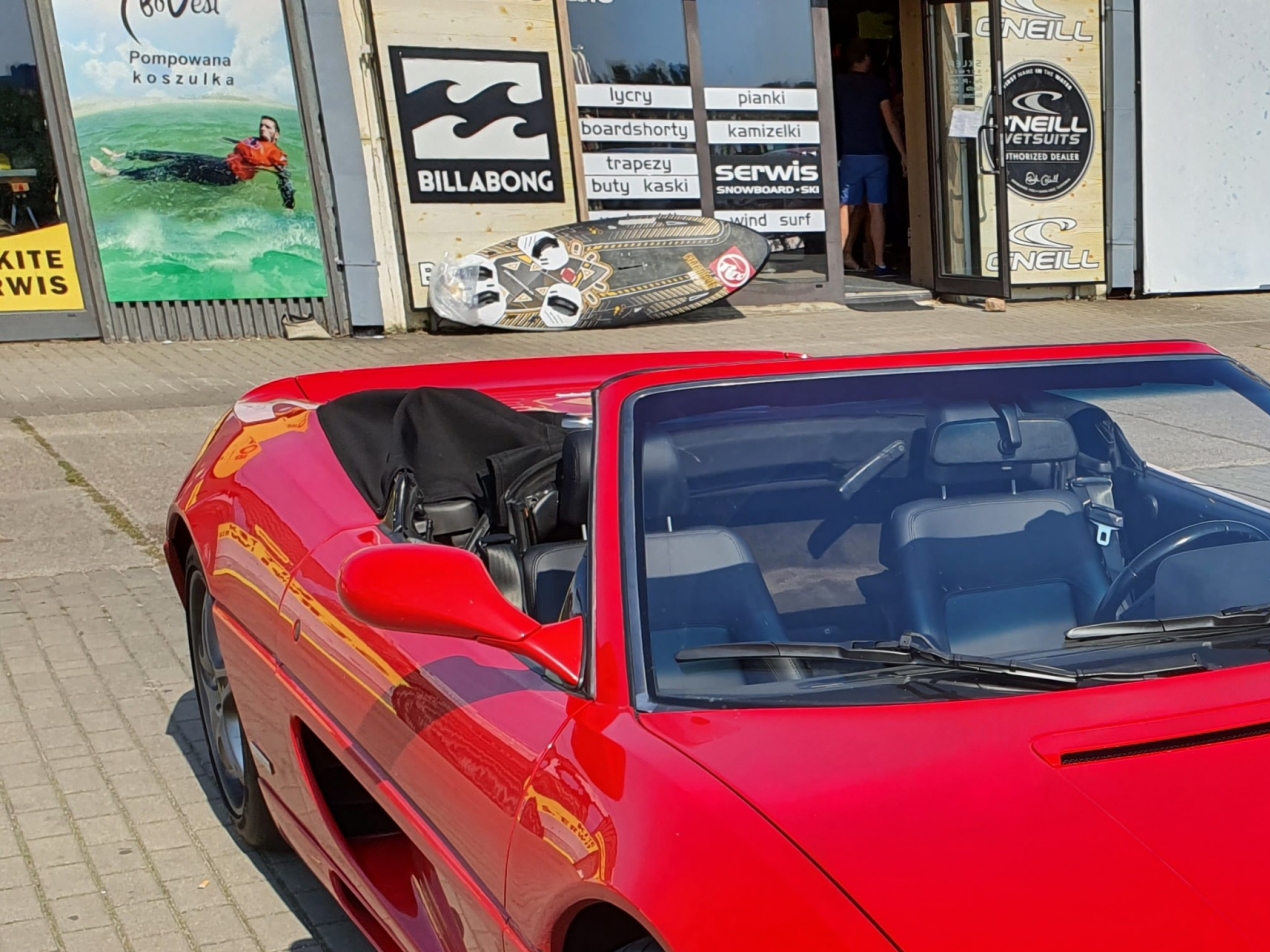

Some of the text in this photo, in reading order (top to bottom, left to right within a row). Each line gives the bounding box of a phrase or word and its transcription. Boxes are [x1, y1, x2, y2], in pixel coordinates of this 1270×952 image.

[129, 50, 232, 68] Pompowana
[132, 70, 235, 86] koszulka
[609, 87, 653, 106] lycry
[738, 90, 786, 107] pianki
[581, 120, 689, 140] boardshorty
[728, 124, 802, 138] kamizelki
[606, 156, 672, 173] trapezy
[1050, 152, 1080, 161] DEALER
[715, 160, 819, 182] serwis
[417, 170, 555, 193] BILLABONG
[591, 178, 689, 196] buty kaski
[716, 185, 820, 195] SNOWBOARD SKI
[730, 212, 812, 227] wind surf
[0, 249, 65, 270] KITE
[0, 275, 69, 297] WIS
